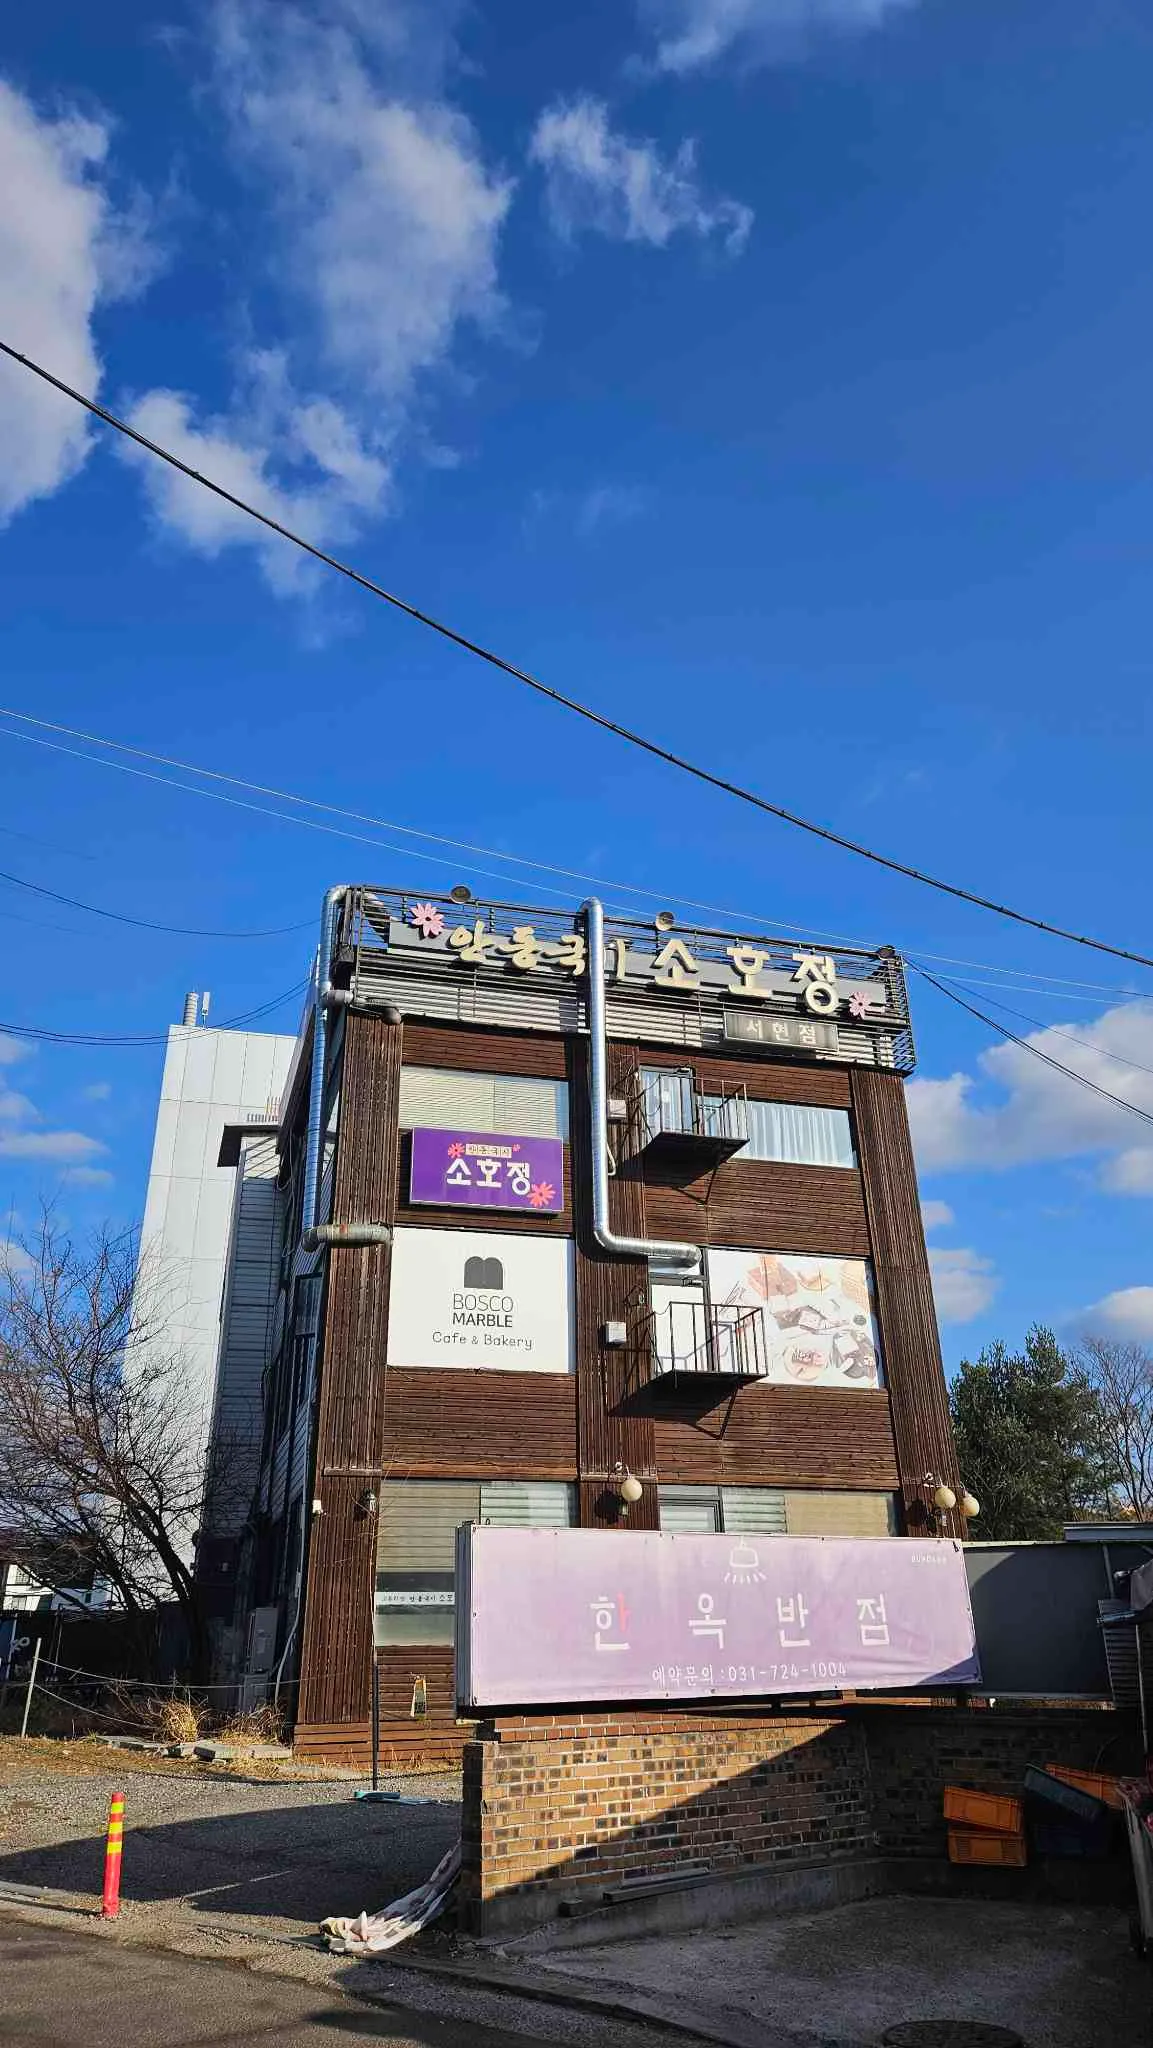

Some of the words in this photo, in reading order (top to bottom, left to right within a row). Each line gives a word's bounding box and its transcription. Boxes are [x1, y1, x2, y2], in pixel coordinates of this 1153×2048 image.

[649, 938, 841, 1015] 소호정
[745, 1017, 817, 1045] 서현점
[446, 1157, 531, 1196] 소호정
[452, 1293, 514, 1313] BOSCO
[452, 1312, 514, 1328] MARBLE
[432, 1331, 468, 1345] Cafe
[471, 1335, 479, 1345] &
[483, 1334, 533, 1351] Bakery
